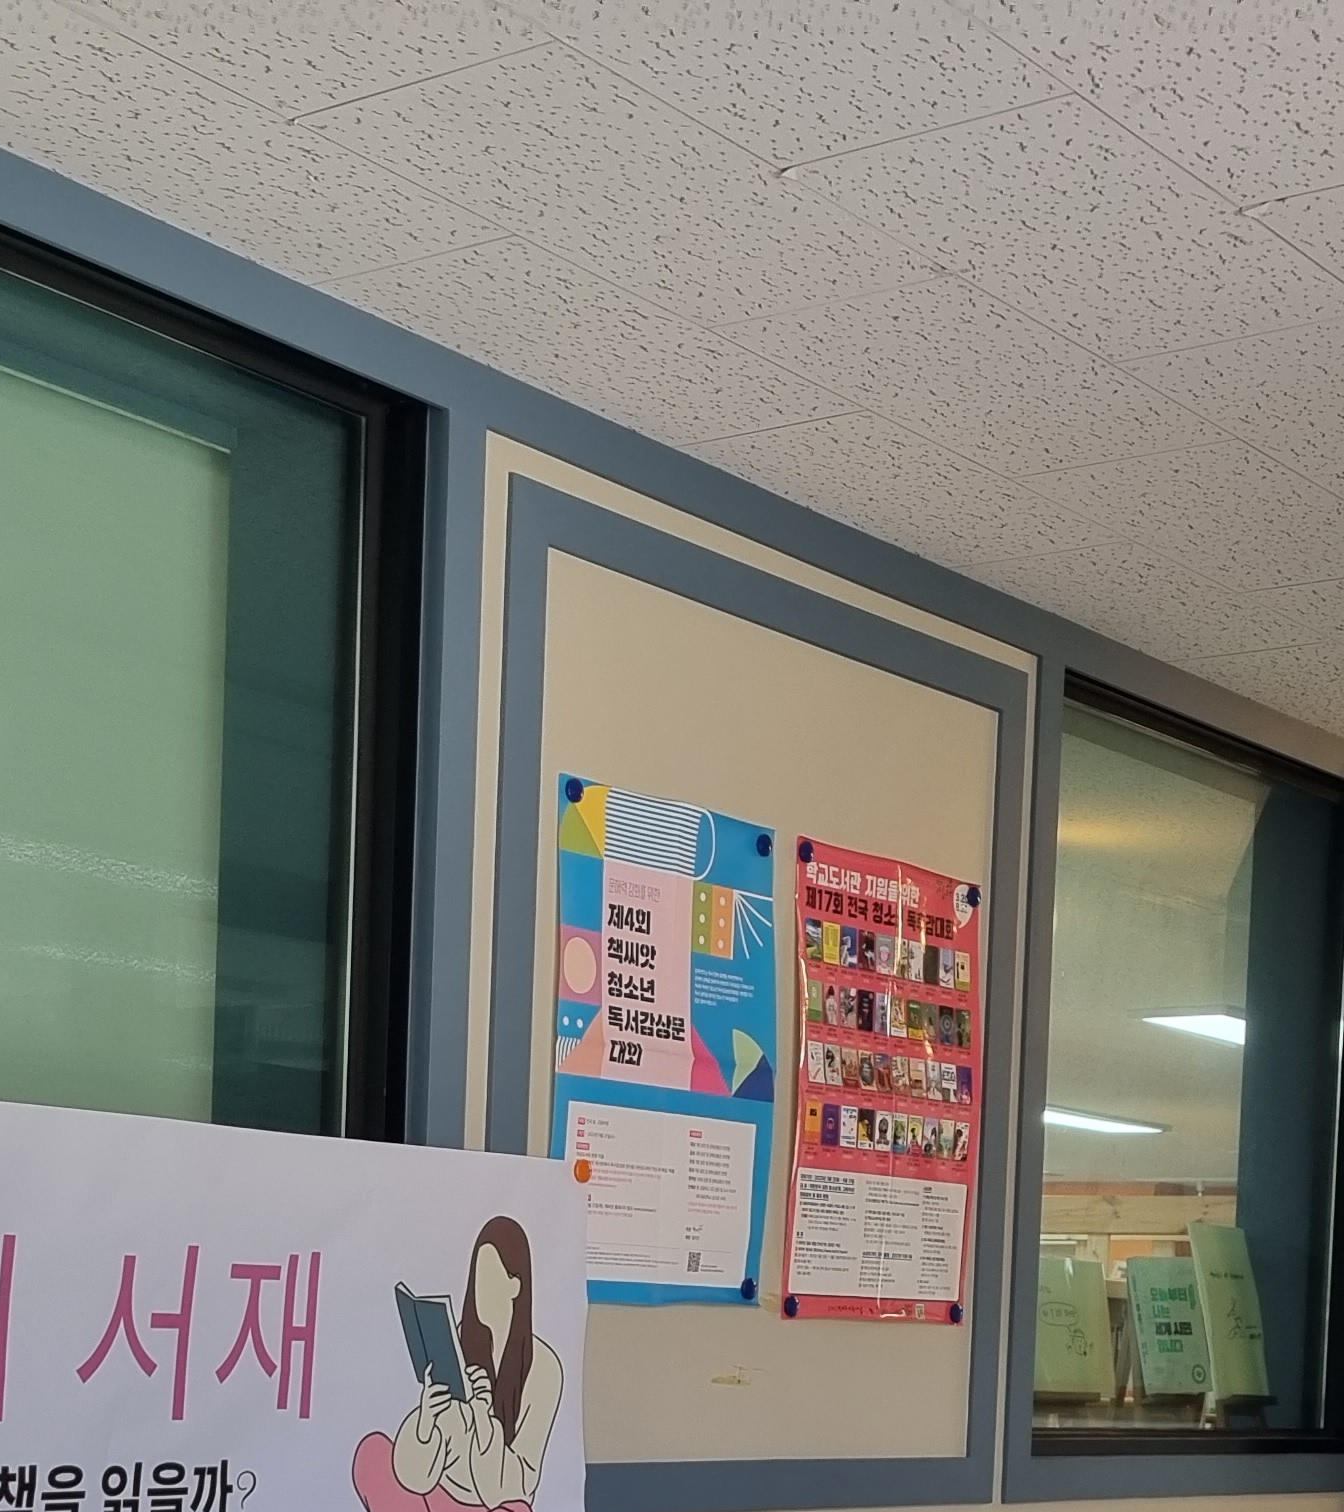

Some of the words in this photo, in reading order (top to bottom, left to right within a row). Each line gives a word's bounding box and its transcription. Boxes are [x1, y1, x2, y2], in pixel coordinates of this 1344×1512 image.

[805, 861, 861, 893] 학교도서관
[607, 903, 651, 935] 제4회
[805, 886, 843, 915] 제17회
[847, 895, 869, 921] 전국
[872, 901, 902, 927] 청소
[607, 936, 656, 970] 책씨앗
[607, 971, 655, 1003] 청소년
[608, 1005, 685, 1041] 독서감상문
[609, 1040, 643, 1066] 대회
[76, 1245, 322, 1421] 서재
